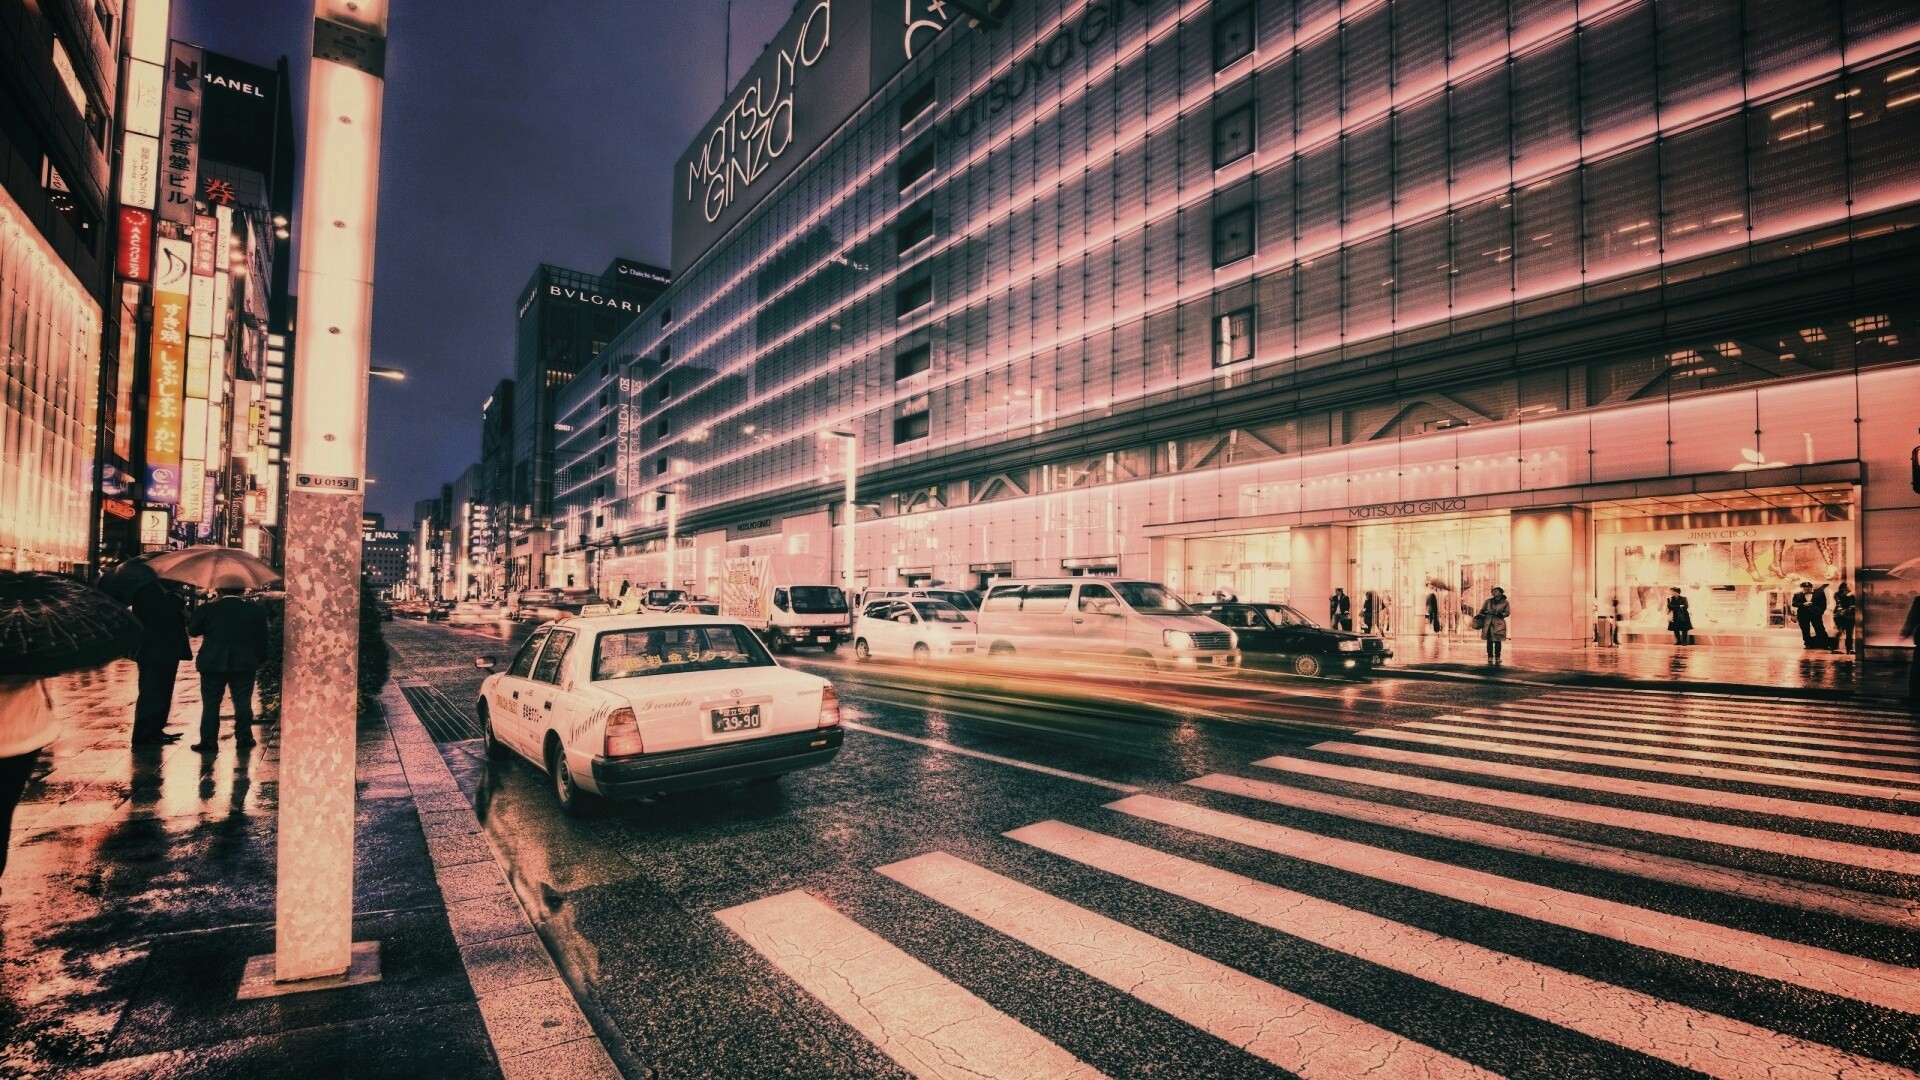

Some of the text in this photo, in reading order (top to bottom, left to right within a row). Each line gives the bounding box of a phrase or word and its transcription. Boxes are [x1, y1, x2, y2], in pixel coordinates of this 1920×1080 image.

[168, 106, 193, 205] 日本香堂ビル
[550, 285, 642, 313] BVLGARI
[314, 478, 322, 486] U
[324, 479, 349, 488] 0153
[375, 531, 399, 540] INAX
[1688, 528, 1757, 540] JIMMY CHOO
[723, 713, 759, 732] 39-90
